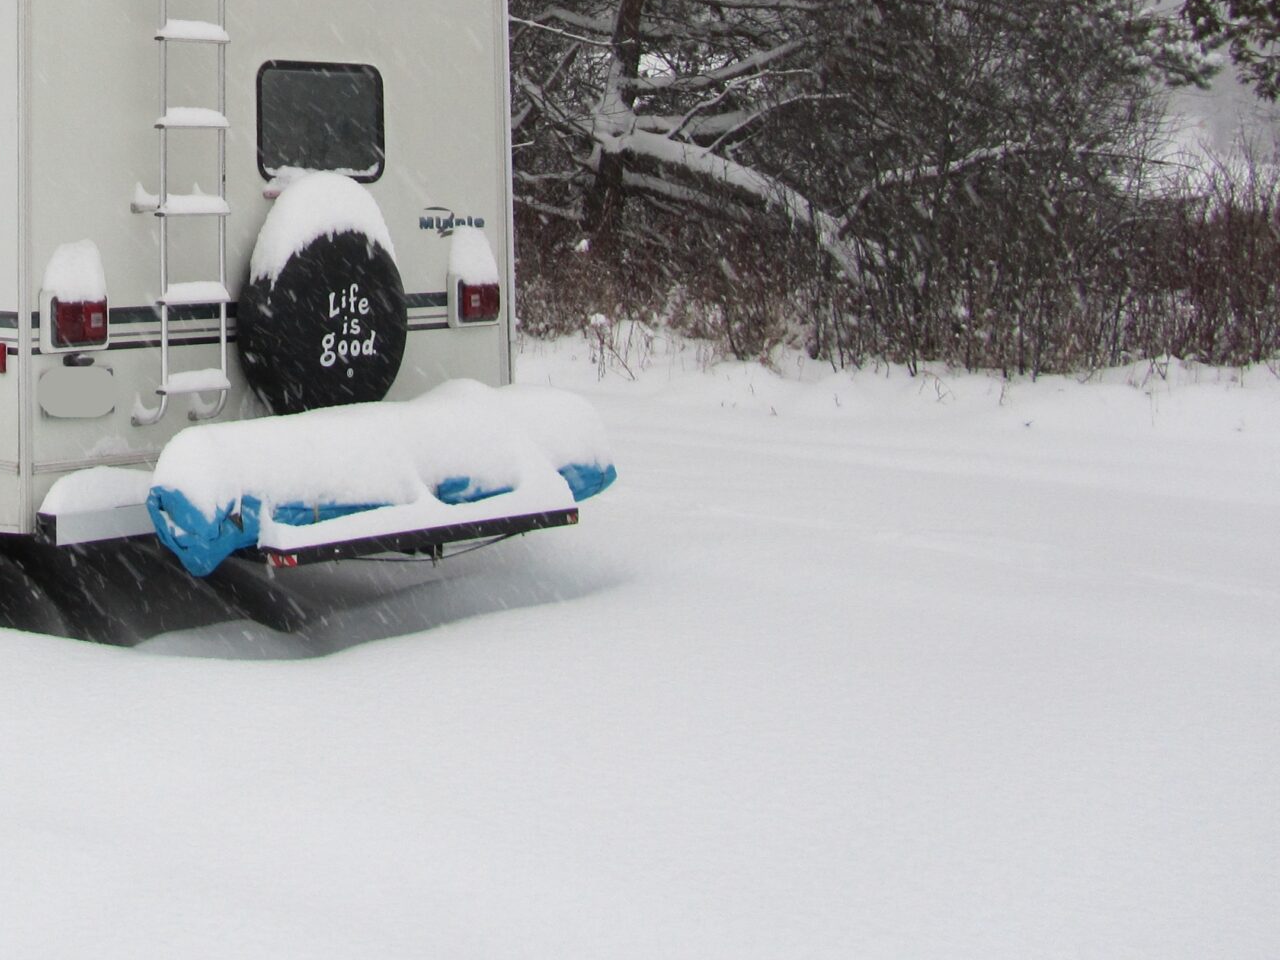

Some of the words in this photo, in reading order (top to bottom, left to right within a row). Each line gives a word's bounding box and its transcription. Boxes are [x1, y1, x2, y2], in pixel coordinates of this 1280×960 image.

[328, 283, 370, 318] Life
[342, 316, 360, 335] is
[320, 329, 376, 367] good.
